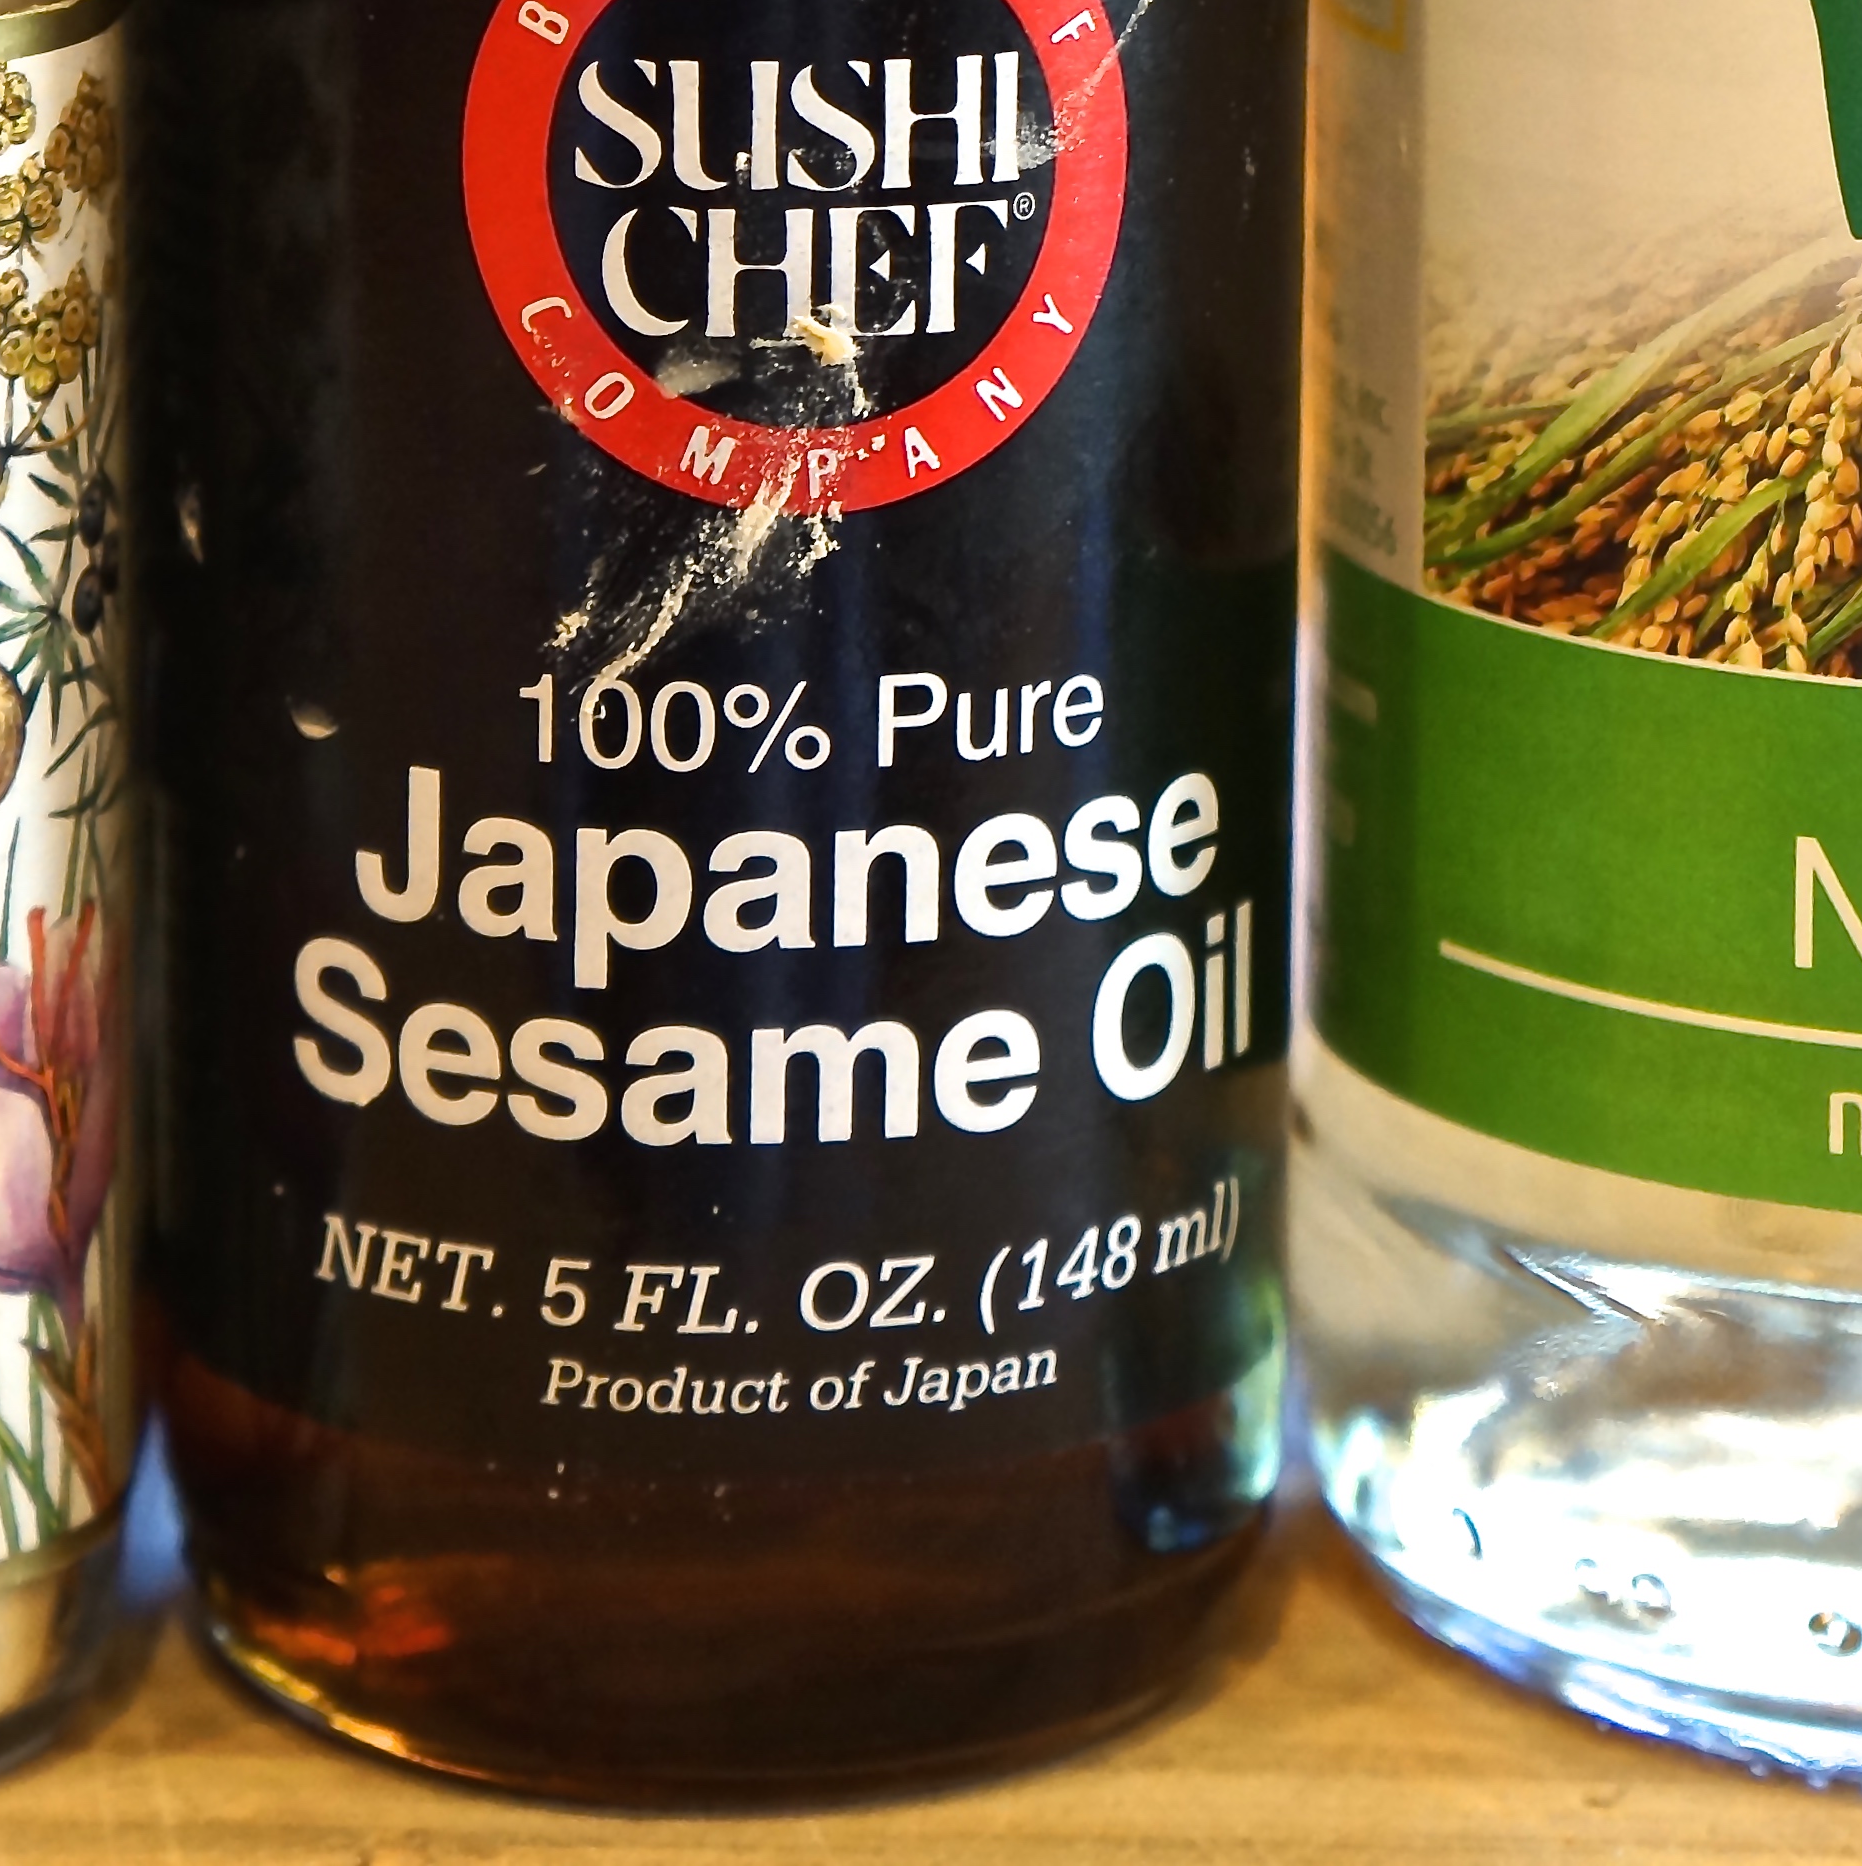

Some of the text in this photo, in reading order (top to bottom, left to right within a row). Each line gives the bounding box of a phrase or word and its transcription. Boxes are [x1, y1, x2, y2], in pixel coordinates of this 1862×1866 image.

[574, 51, 1020, 190] SUSHI
[601, 200, 1009, 338] CHEF
[520, 293, 1074, 500] COMPANY
[519, 671, 1106, 774] 100% Pure
[355, 768, 1221, 990] Japanese
[292, 901, 1252, 1147] Sesame Oil
[316, 1176, 1242, 1335] NET. 5 FL. OZ. (148 ml)
[540, 1347, 1058, 1417] Product of Japan
